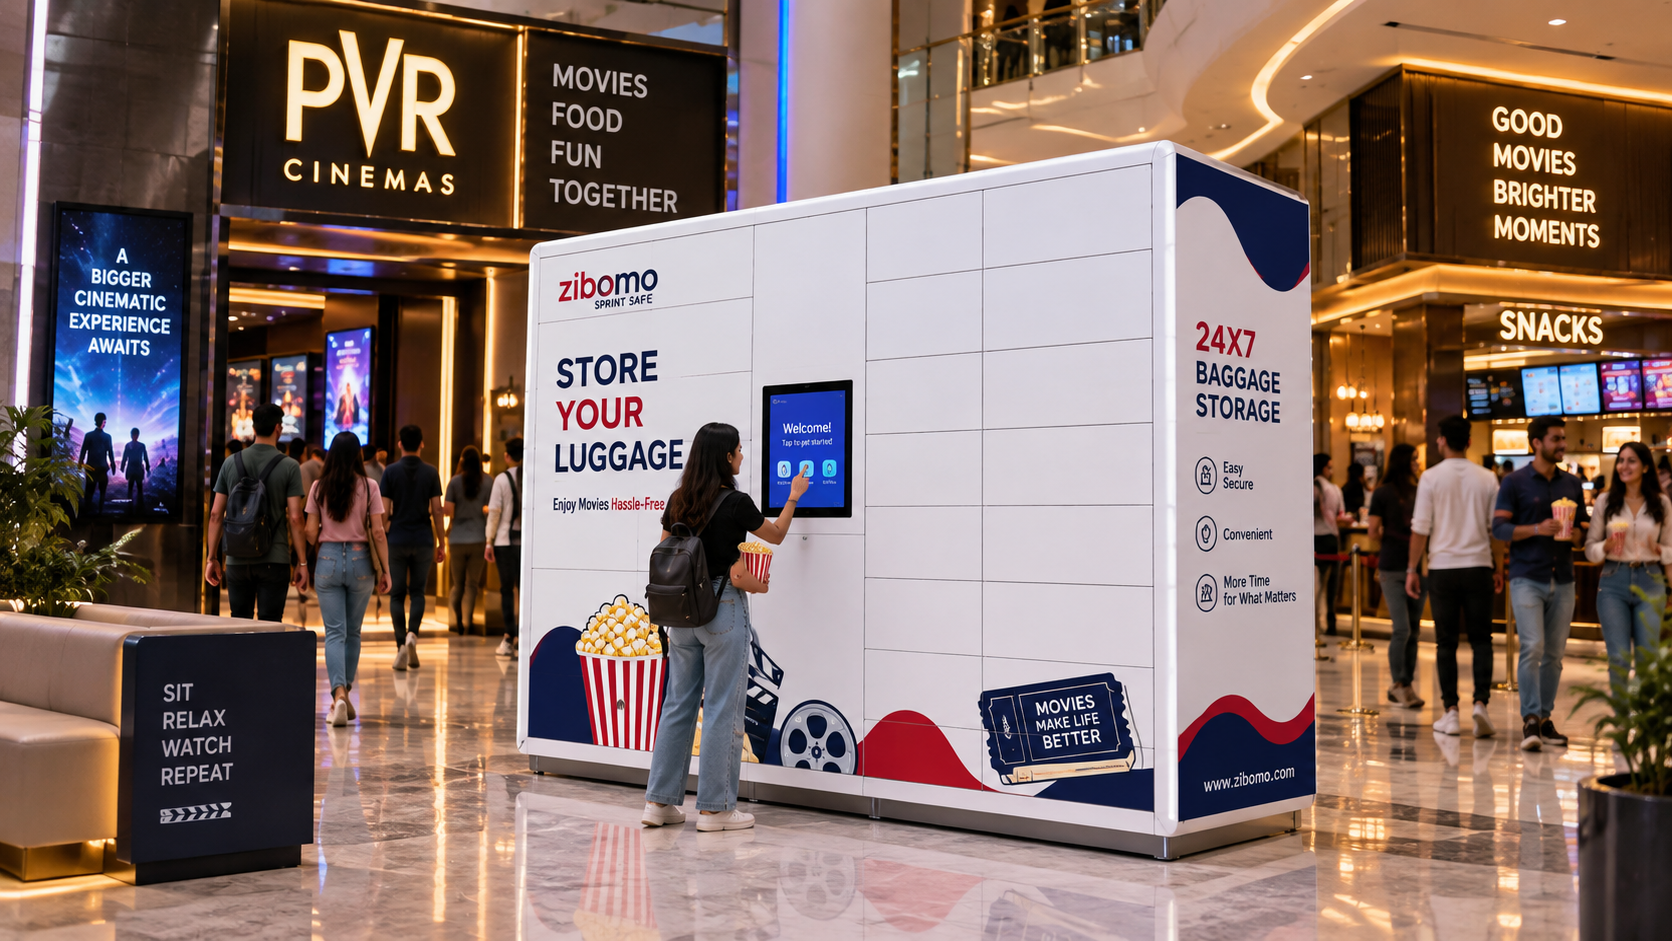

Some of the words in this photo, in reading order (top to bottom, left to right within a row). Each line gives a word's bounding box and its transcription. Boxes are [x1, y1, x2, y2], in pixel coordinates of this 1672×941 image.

[553, 63, 648, 98] MOVIES
[286, 29, 456, 158] PVR
[552, 101, 623, 133] FOOD
[1492, 106, 1563, 138] GOOD
[551, 140, 602, 169] FUN
[1493, 142, 1577, 176] MOVIES
[283, 158, 455, 195] CINEMAS
[549, 178, 678, 213] TOGETHER
[1493, 179, 1597, 214] BRIGHTER
[1494, 214, 1601, 249] MOMENTS
[116, 248, 129, 264] A
[91, 268, 151, 288] BIGGER
[558, 269, 658, 302] zibomo
[74, 290, 166, 311] CINEMATIC
[594, 297, 626, 309] SPRINT
[629, 293, 653, 306] SAFE
[69, 312, 171, 334] EXPERIENCE
[1500, 310, 1604, 345] SNACKS
[88, 337, 150, 356] AWAITS
[1195, 321, 1256, 358] 24X7
[556, 350, 658, 389] STORE
[1196, 361, 1281, 394] BAGGAGE
[556, 396, 643, 431] YOUR
[1195, 393, 1281, 423] STORAGE
[782, 421, 832, 434] Welcome!
[555, 439, 683, 473] LUGGAGE
[1223, 461, 1244, 477] Easy
[1223, 477, 1254, 490] Secure
[553, 497, 577, 514] Enjoy
[578, 497, 609, 511] Movies
[611, 496, 665, 511] Hassle-Free
[1223, 528, 1273, 541] Convenient
[1223, 576, 1247, 588] More
[1249, 574, 1270, 587] Time
[1223, 592, 1237, 606] for
[1239, 592, 1262, 605] What
[1264, 590, 1297, 604] Matters
[163, 683, 194, 702] SIT
[1035, 694, 1095, 716] MOVIES
[163, 709, 226, 730] RELAX
[1036, 716, 1070, 732] MAKE
[1073, 712, 1100, 727] LIFE
[162, 736, 232, 757] WATCH
[1042, 729, 1102, 749] BETTER
[161, 762, 234, 786] REPEAT
[1203, 765, 1295, 793] www.zibomo.com
